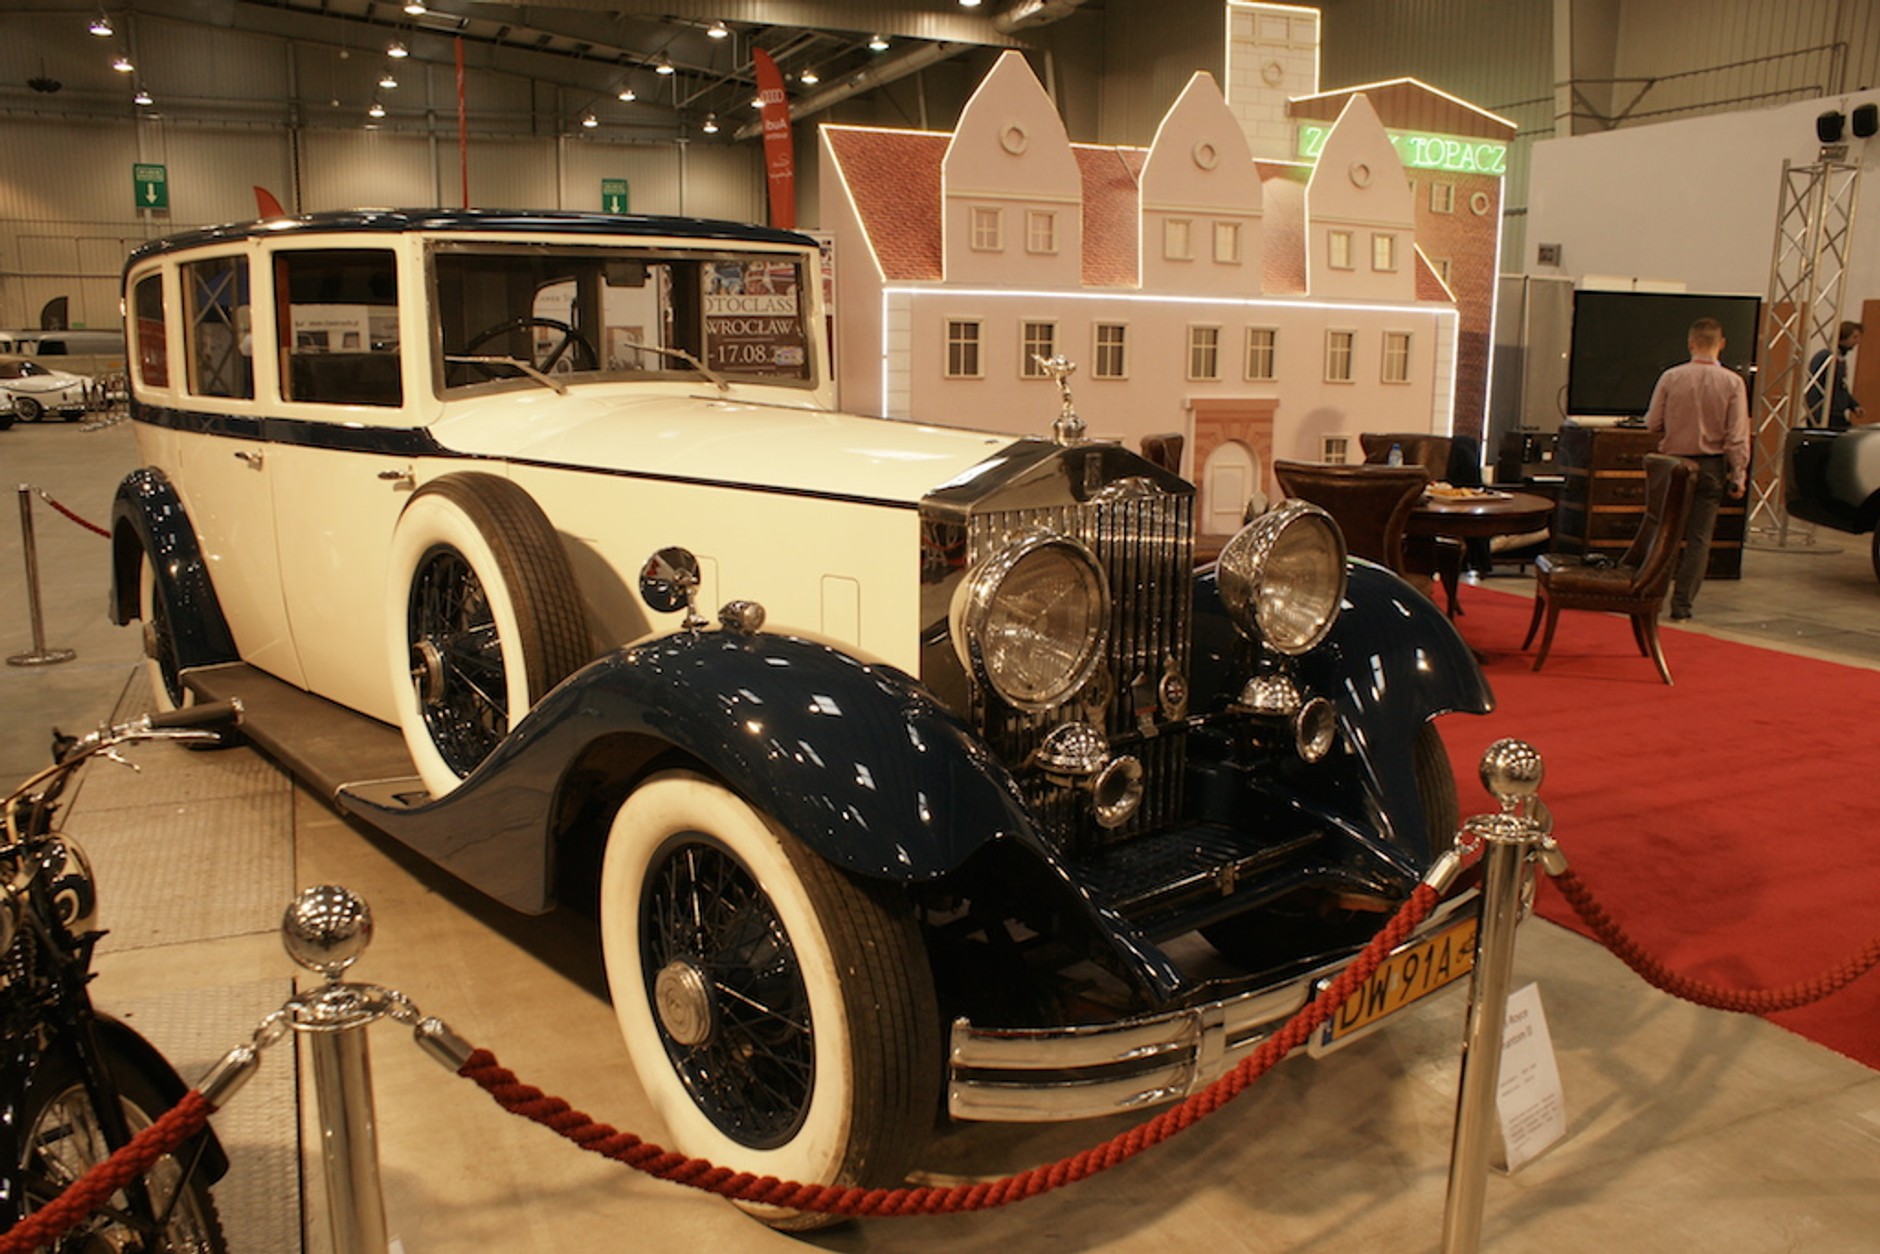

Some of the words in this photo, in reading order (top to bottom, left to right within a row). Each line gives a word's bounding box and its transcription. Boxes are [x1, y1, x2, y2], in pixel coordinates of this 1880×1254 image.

[1411, 136, 1507, 173] TOPACZ
[1340, 963, 1392, 1030] DW
[1399, 936, 1451, 1002] 91A
